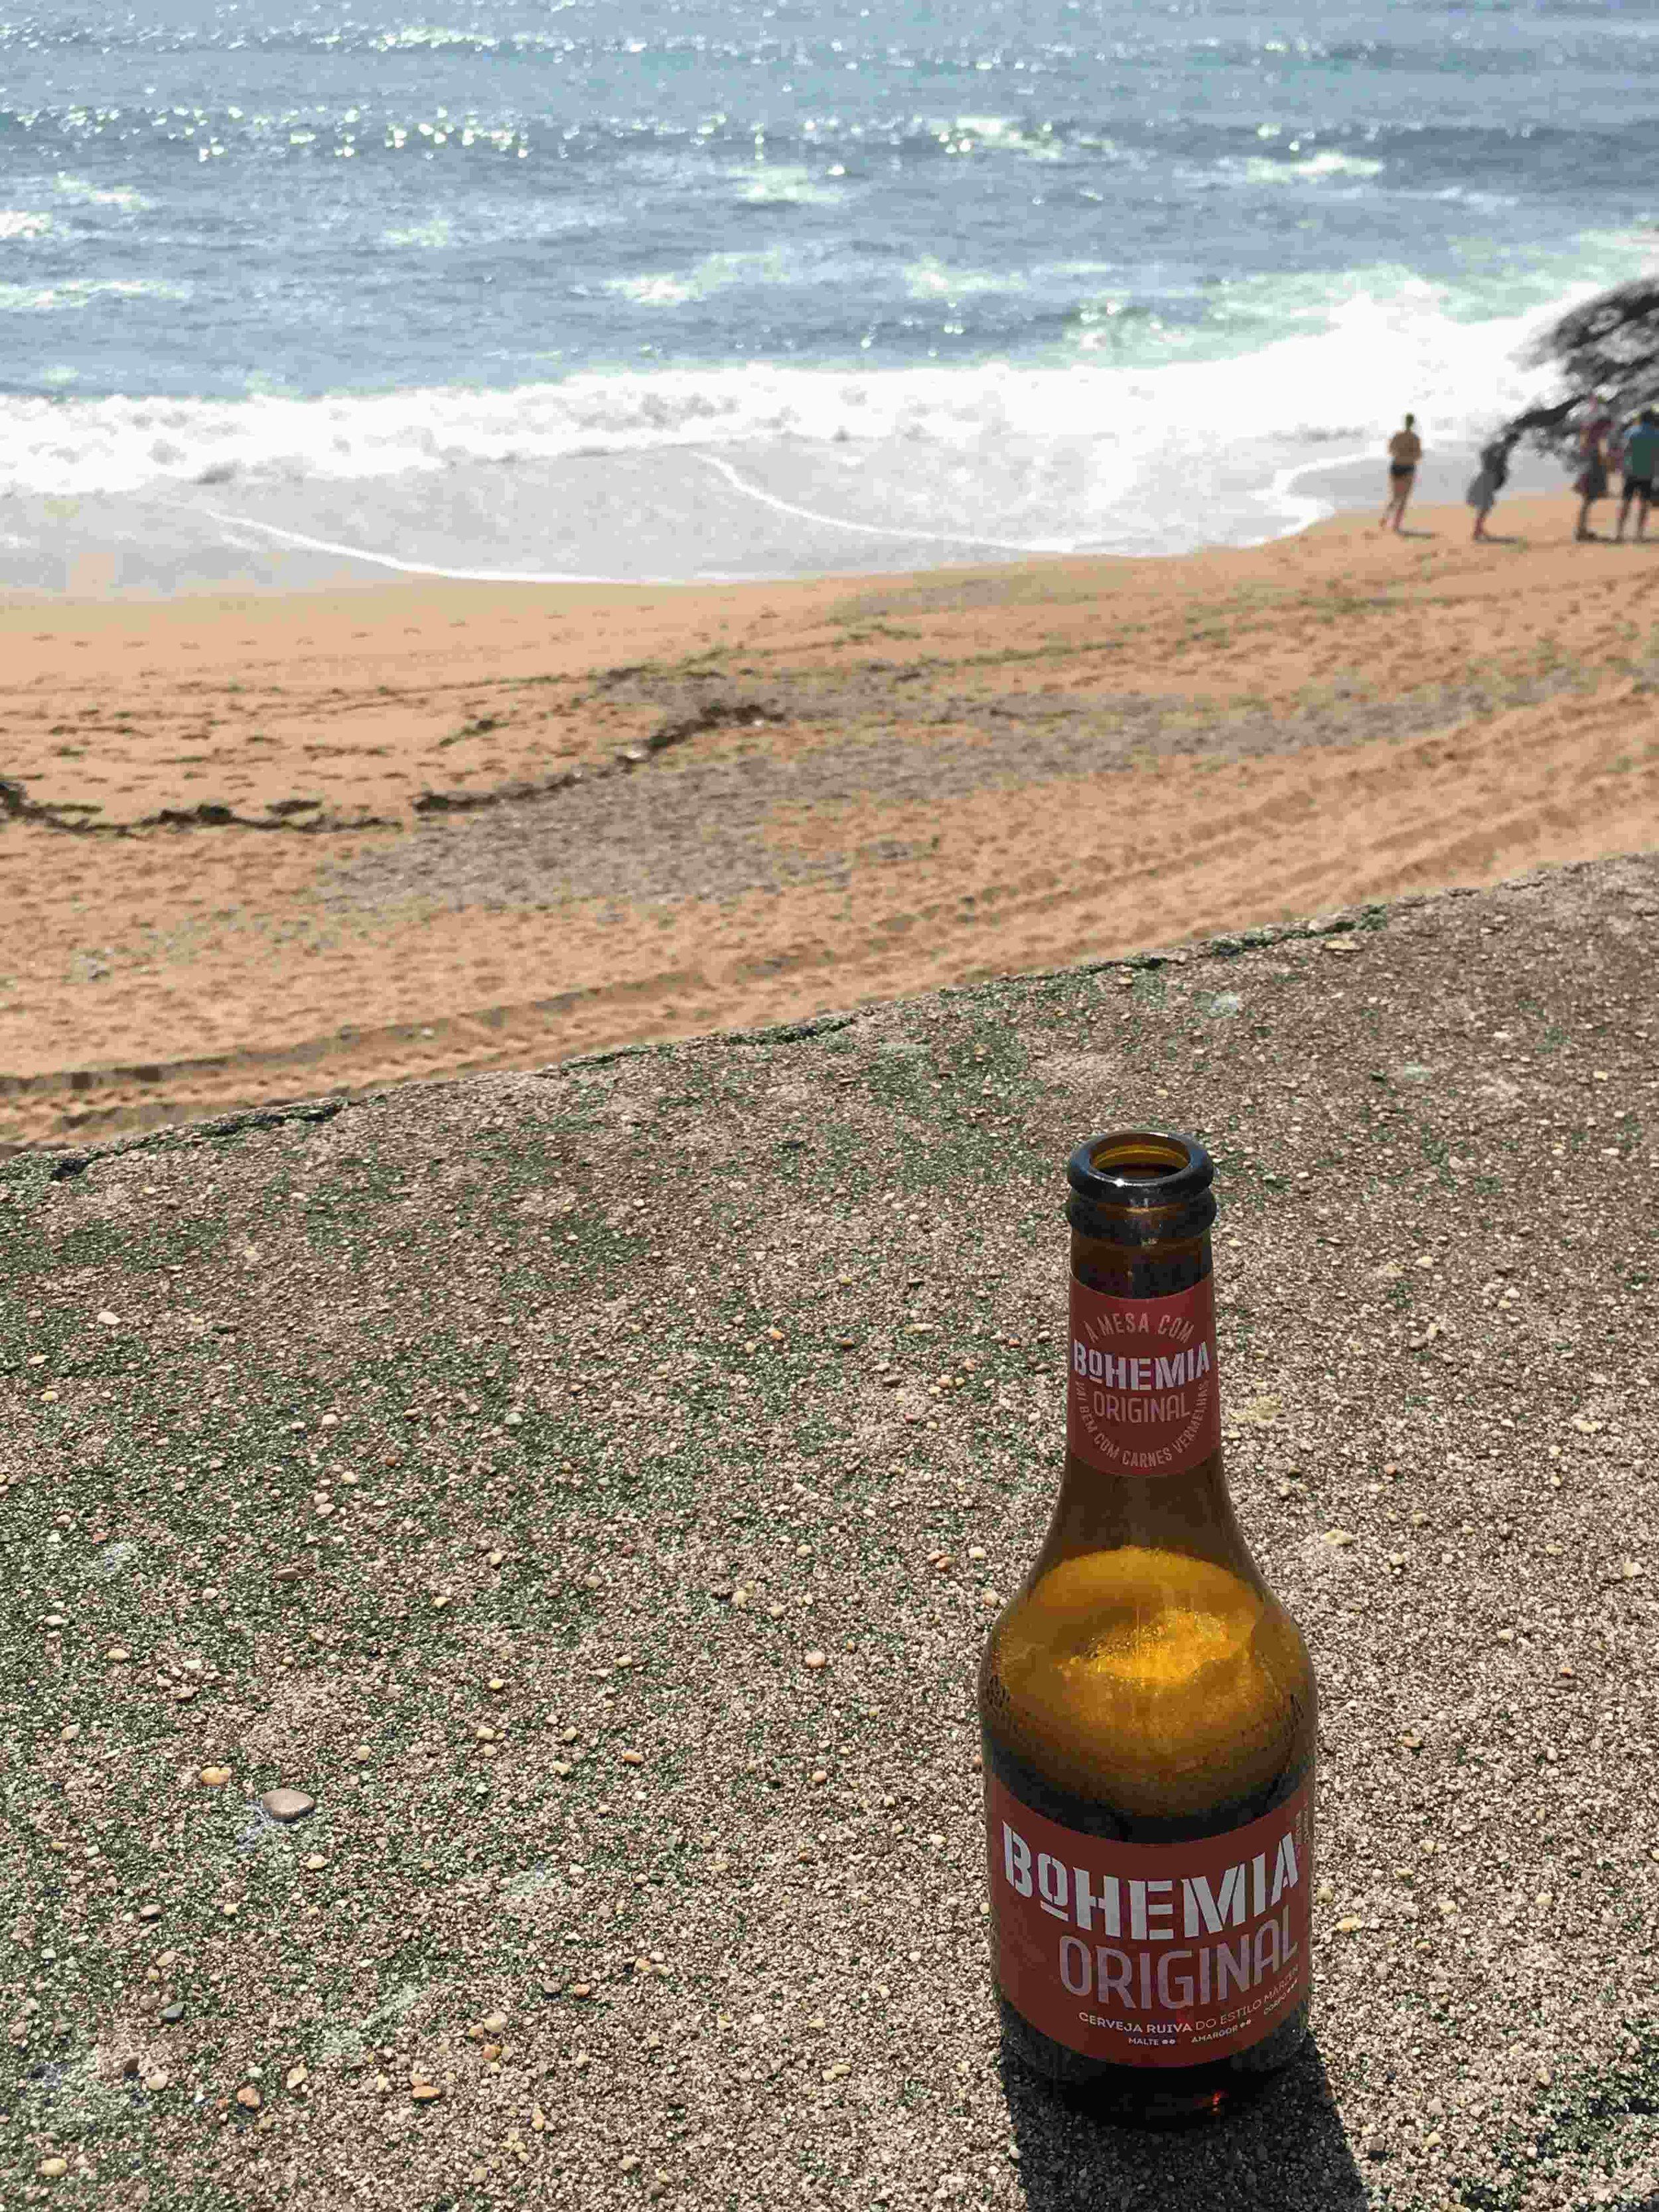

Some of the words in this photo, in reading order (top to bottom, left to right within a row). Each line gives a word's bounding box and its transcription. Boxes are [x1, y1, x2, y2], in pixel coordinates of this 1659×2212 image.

[1097, 1312, 1149, 1336] MESA
[1157, 1315, 1194, 1344] COM
[1073, 1338, 1210, 1391] BOHEMIA
[1093, 1390, 1190, 1423] ORIGINAL
[1079, 1406, 1098, 1434] BEM
[1094, 1433, 1119, 1460] COM
[1121, 1447, 1173, 1468] CARNES
[1002, 1820, 1299, 1941] BOHEMIA
[1059, 1904, 1299, 2010] ORIGINAL
[1078, 2012, 1143, 2033] CERVEJA
[1146, 2023, 1193, 2034] RUIVA
[1195, 2018, 1216, 2031] DO
[1220, 1998, 1262, 2025] ESTILO
[1128, 2037, 1159, 2046] MALTE
[1190, 2024, 1238, 2044] AMARGOR
